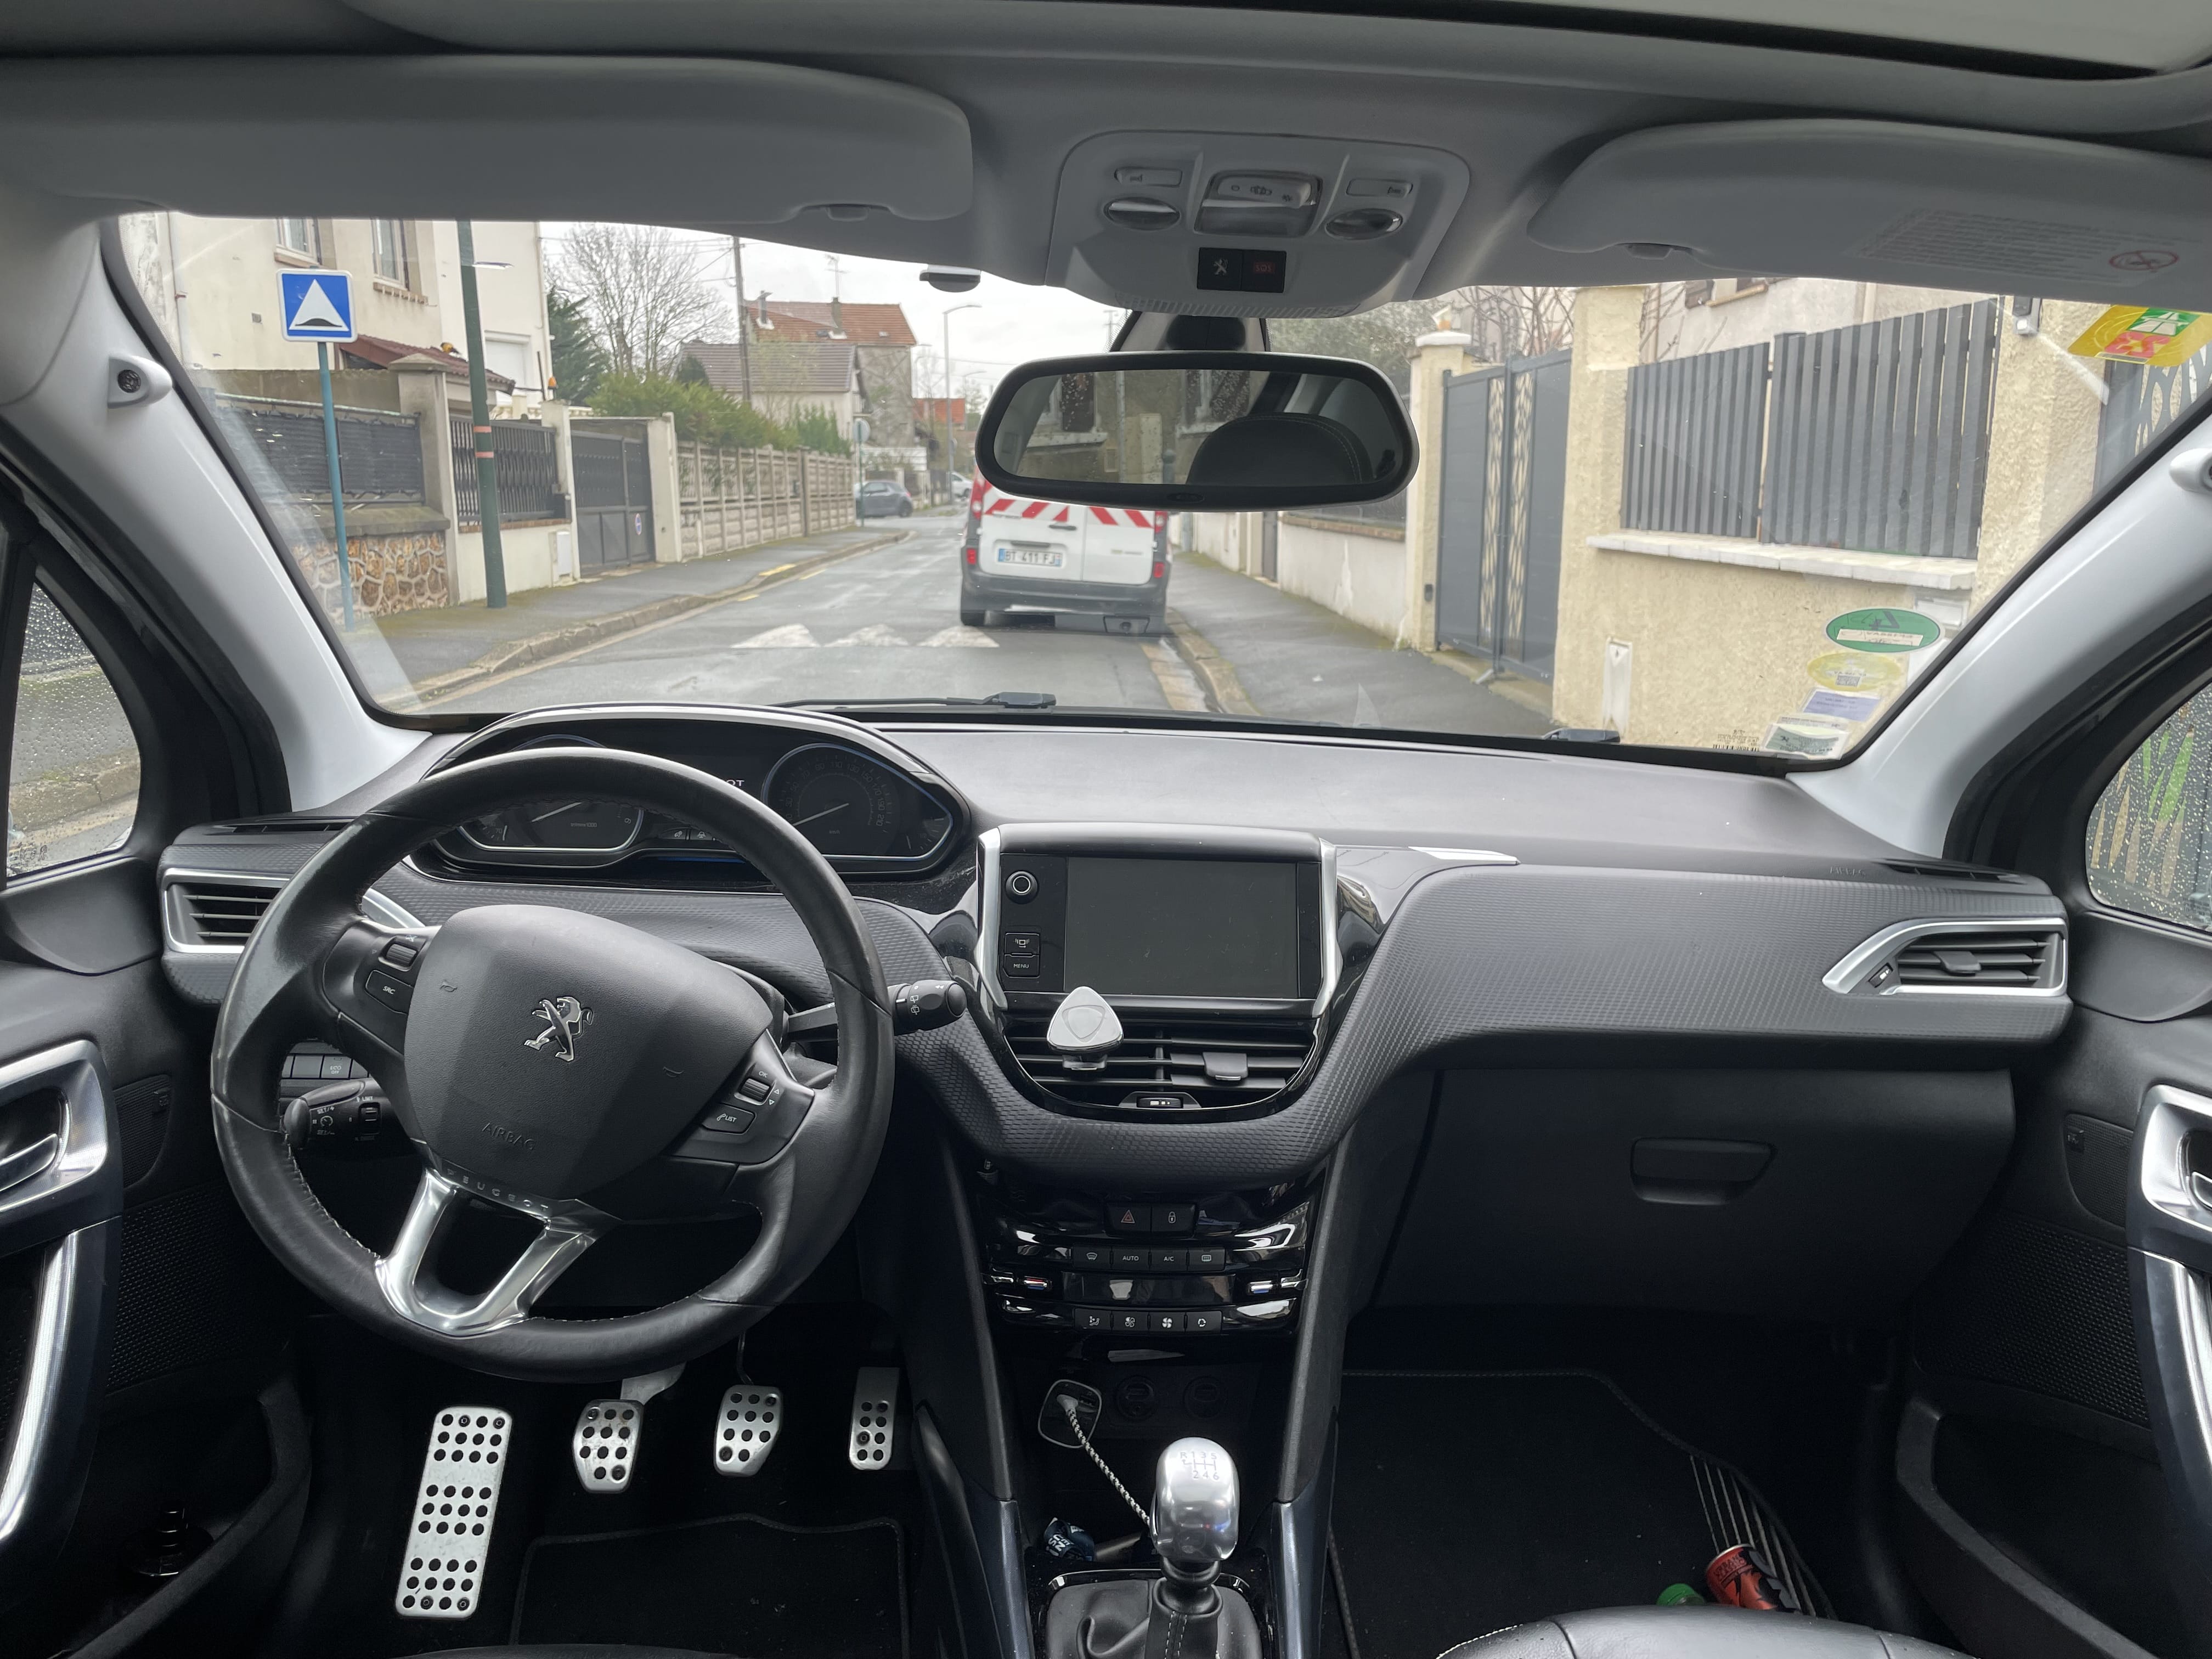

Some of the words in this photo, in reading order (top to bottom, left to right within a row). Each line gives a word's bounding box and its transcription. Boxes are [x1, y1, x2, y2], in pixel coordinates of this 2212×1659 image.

[382, 985, 396, 995] SRC
[482, 1122, 535, 1150] AIRBAG
[447, 1168, 549, 1212] PEUGEOT
[1193, 1470, 1199, 1479] 2
[1202, 1470, 1209, 1479] 4
[1212, 1471, 1220, 1481] 6
